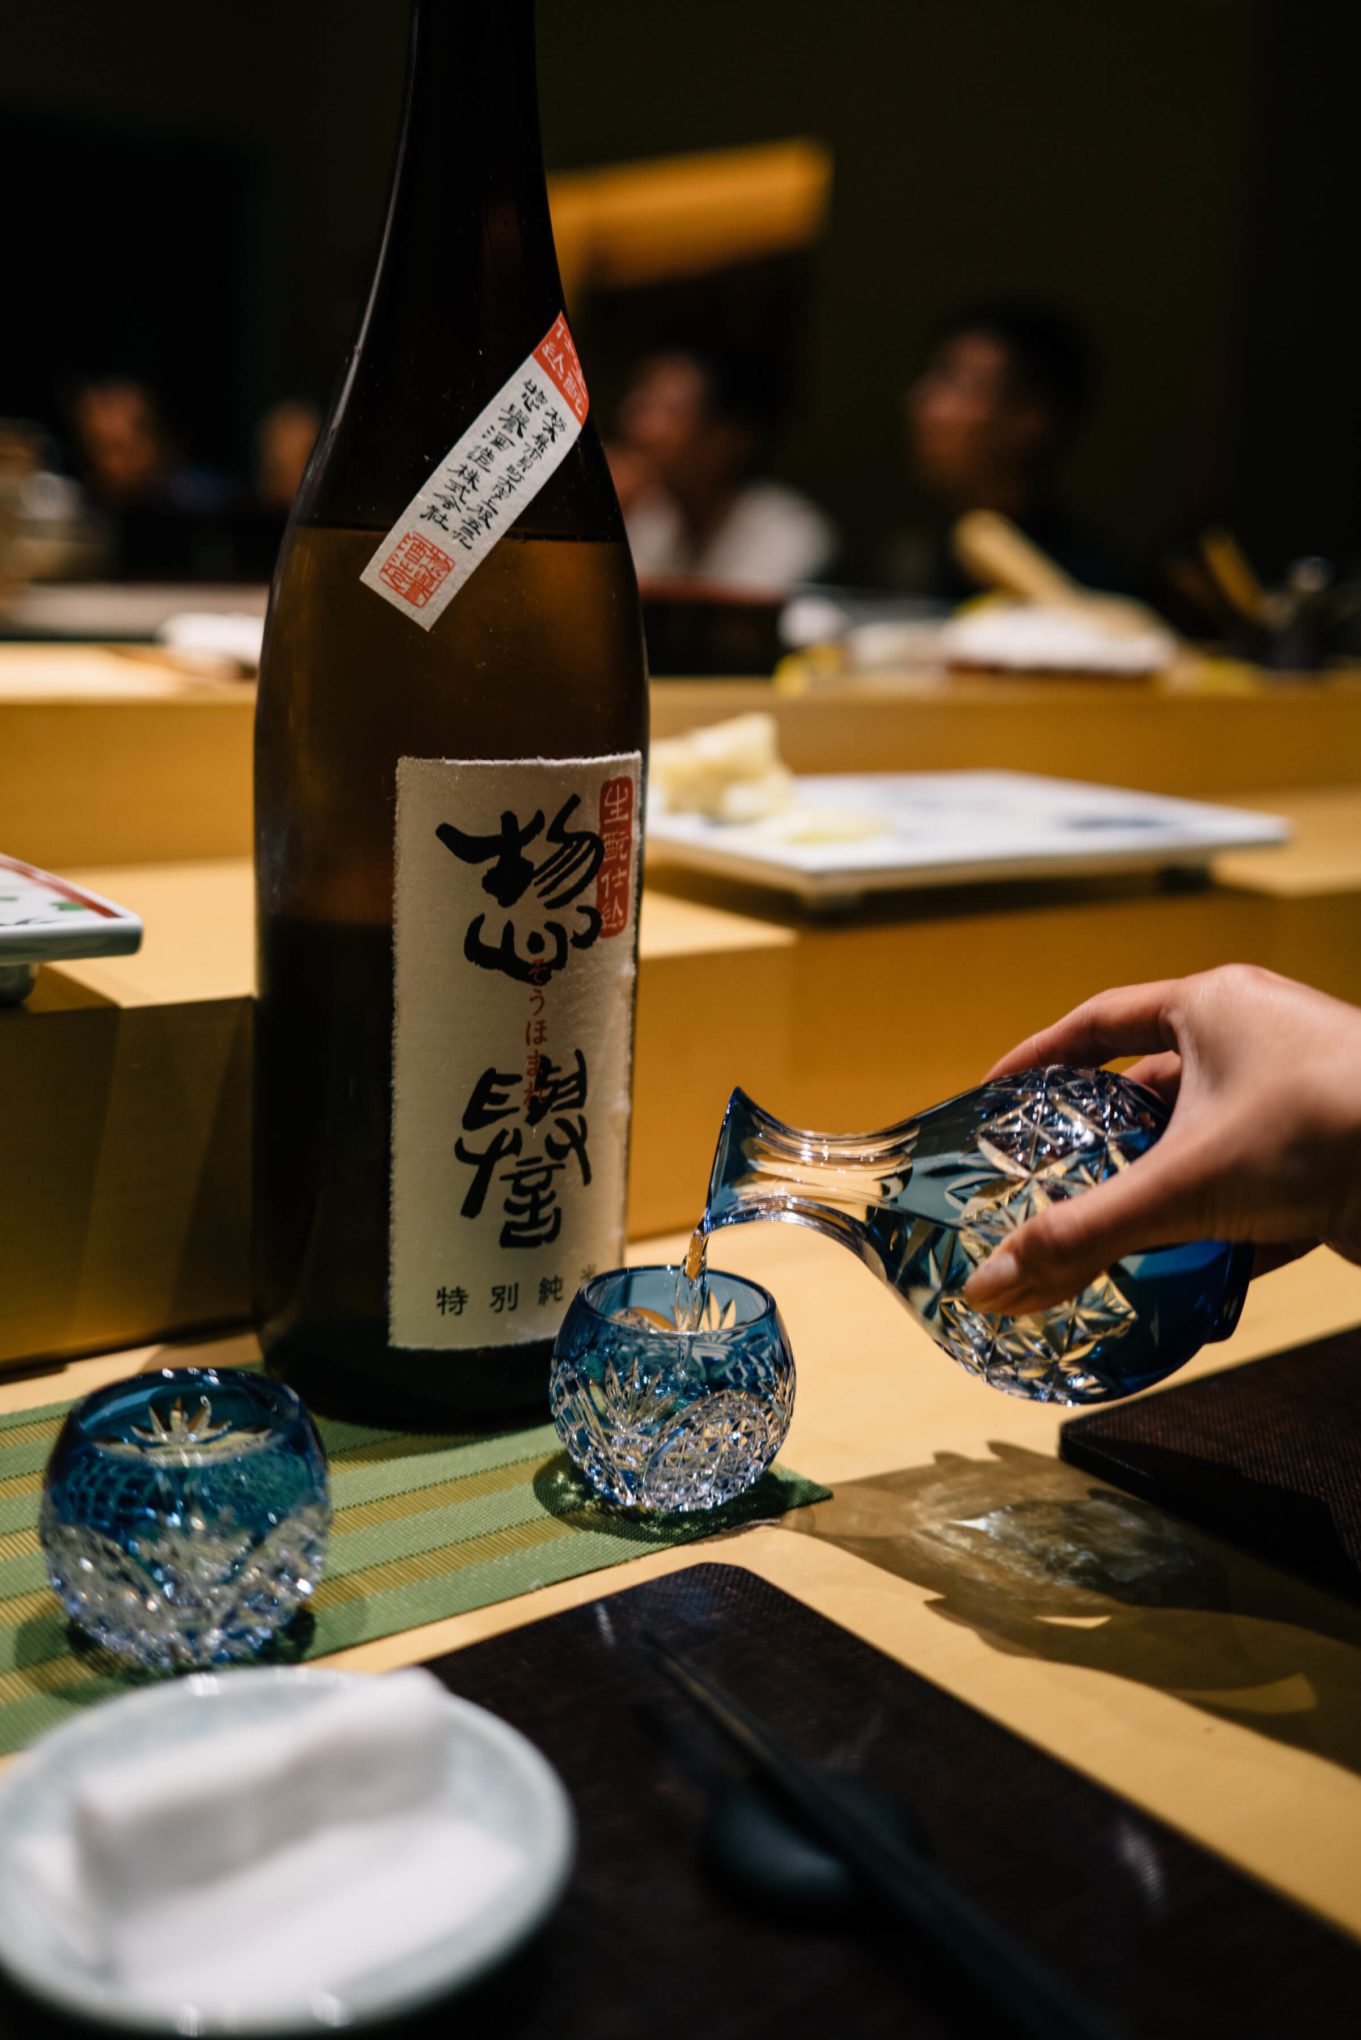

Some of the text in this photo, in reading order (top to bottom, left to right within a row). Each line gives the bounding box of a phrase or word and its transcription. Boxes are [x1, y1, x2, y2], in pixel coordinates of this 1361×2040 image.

[523, 957, 549, 1106] そうほまれ
